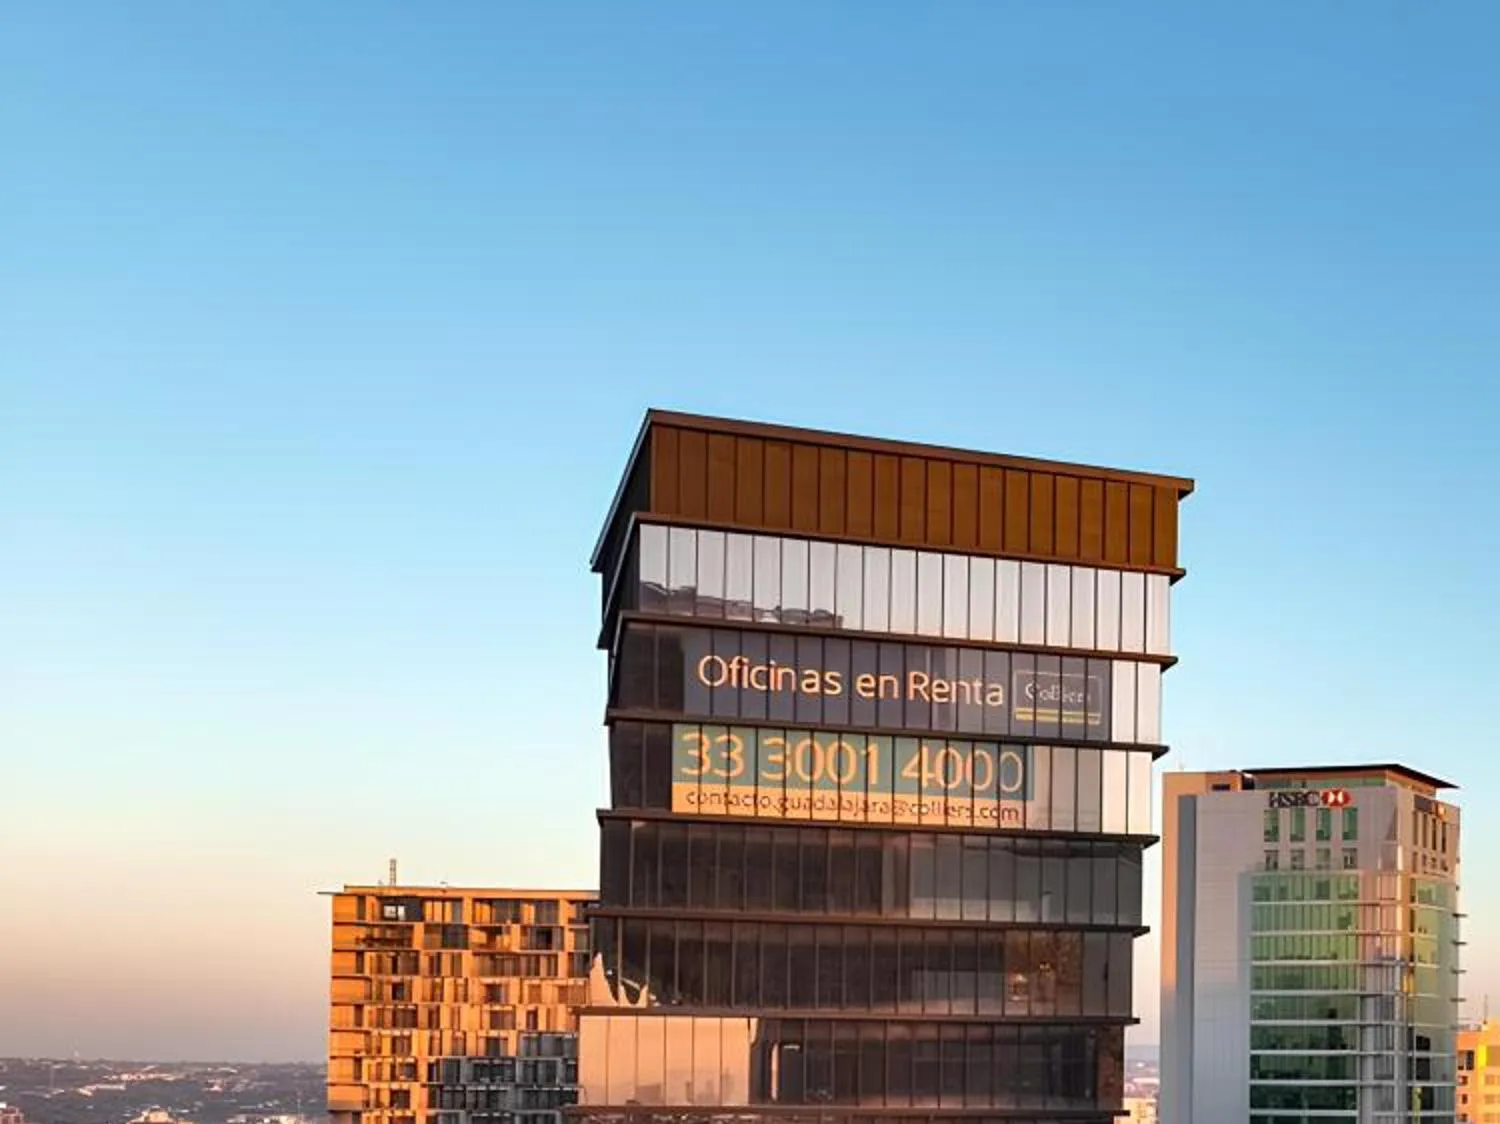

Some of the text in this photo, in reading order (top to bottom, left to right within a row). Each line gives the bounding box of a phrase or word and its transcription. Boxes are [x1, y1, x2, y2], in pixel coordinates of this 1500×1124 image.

[698, 655, 1003, 706] Oficinas en Renta
[681, 731, 1023, 793] 33 3001 4000
[1268, 790, 1320, 808] HSBC
